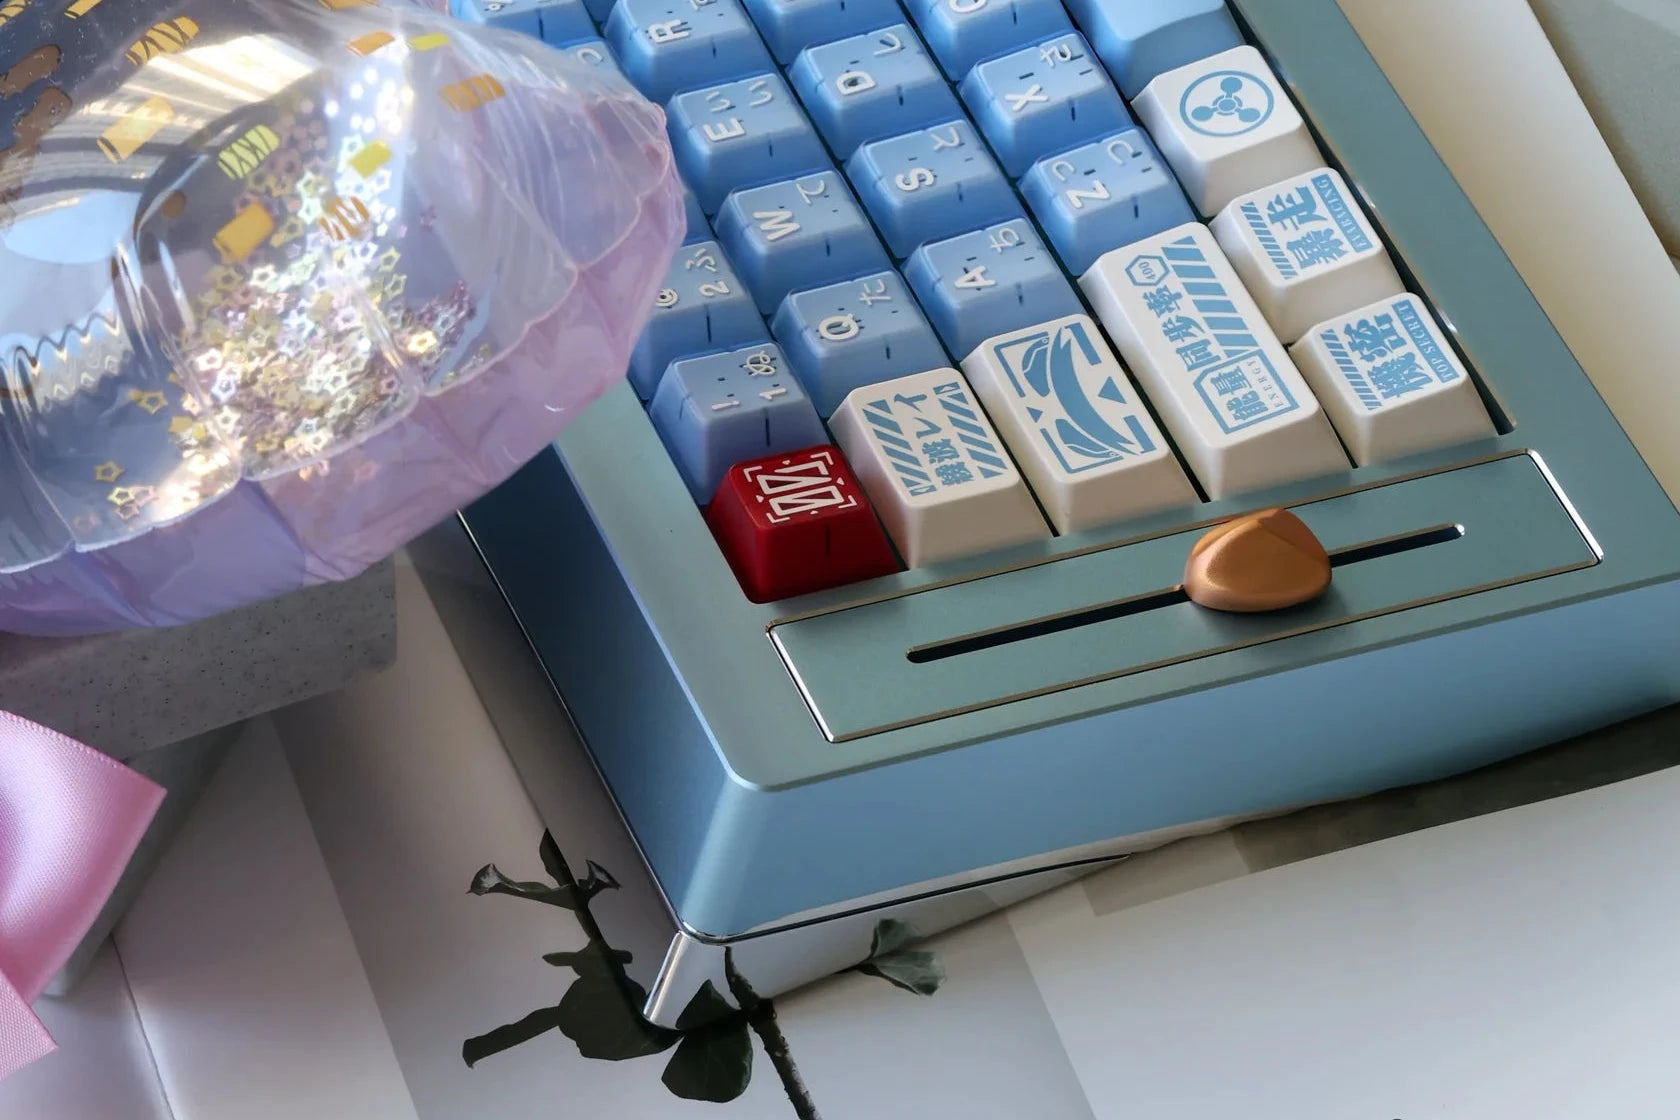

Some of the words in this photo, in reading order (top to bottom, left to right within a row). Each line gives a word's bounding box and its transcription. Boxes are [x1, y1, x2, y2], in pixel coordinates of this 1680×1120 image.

[649, 18, 690, 44] R
[1040, 44, 1072, 68] さ
[836, 71, 876, 96] D
[1004, 84, 1049, 112] X
[703, 117, 746, 142] E
[895, 167, 936, 192] S
[1065, 180, 1111, 209] Z
[753, 207, 801, 241] W
[1266, 186, 1349, 270] 暴走
[954, 265, 996, 290] A
[1138, 261, 1157, 281] 400
[699, 281, 731, 297] 2
[817, 312, 861, 341] Q
[1142, 284, 1222, 373] 同步率
[1397, 304, 1436, 355] SECRET
[1343, 312, 1434, 400] 機密
[1430, 357, 1455, 381] TOP
[759, 387, 787, 401] 1
[1209, 365, 1269, 421] 能量
[1246, 359, 1285, 408] ENERGY
[894, 393, 975, 487] 綾波レイ
